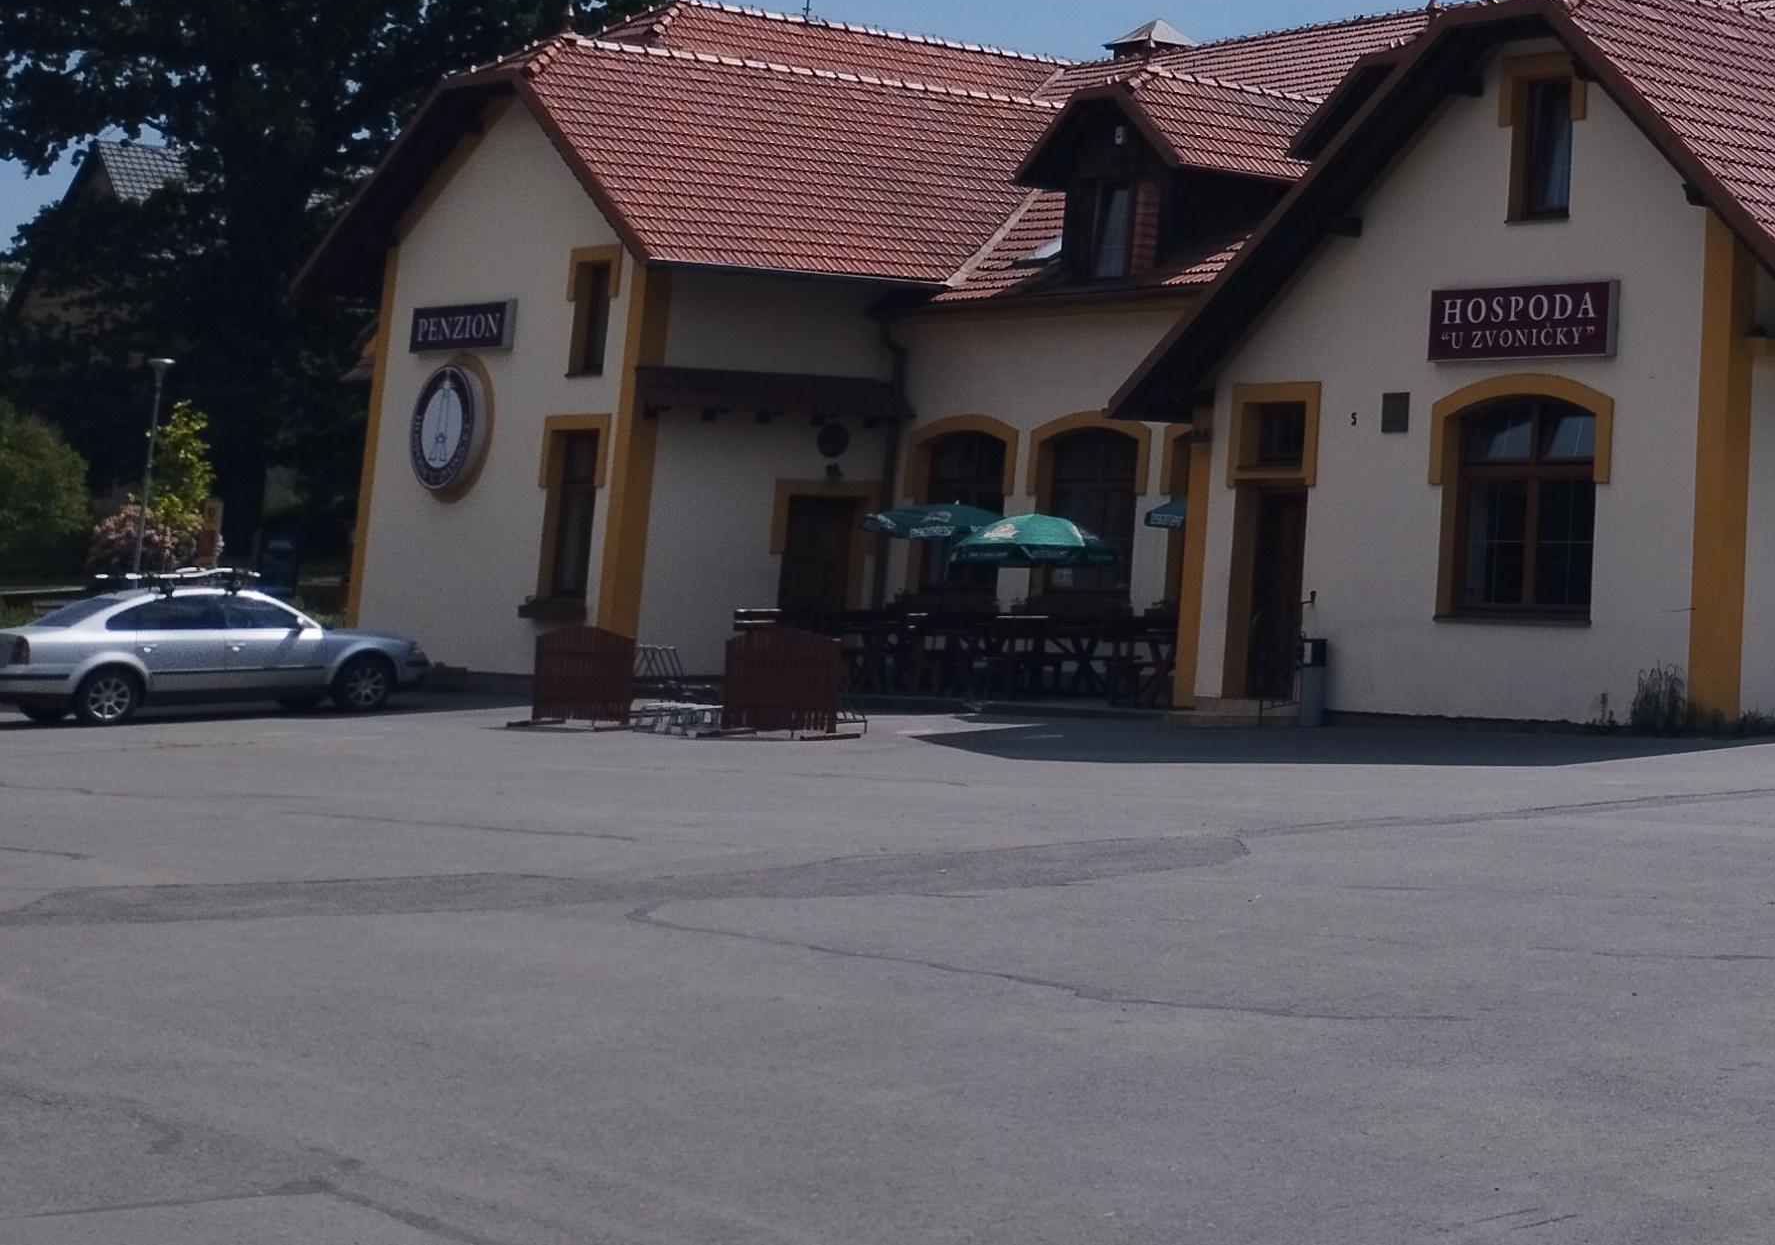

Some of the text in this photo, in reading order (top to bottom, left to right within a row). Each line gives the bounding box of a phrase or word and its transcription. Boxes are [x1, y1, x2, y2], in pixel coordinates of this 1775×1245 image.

[1442, 291, 1596, 325] HOSPODA
[416, 313, 501, 342] PENZION
[1350, 412, 1357, 426] 5
